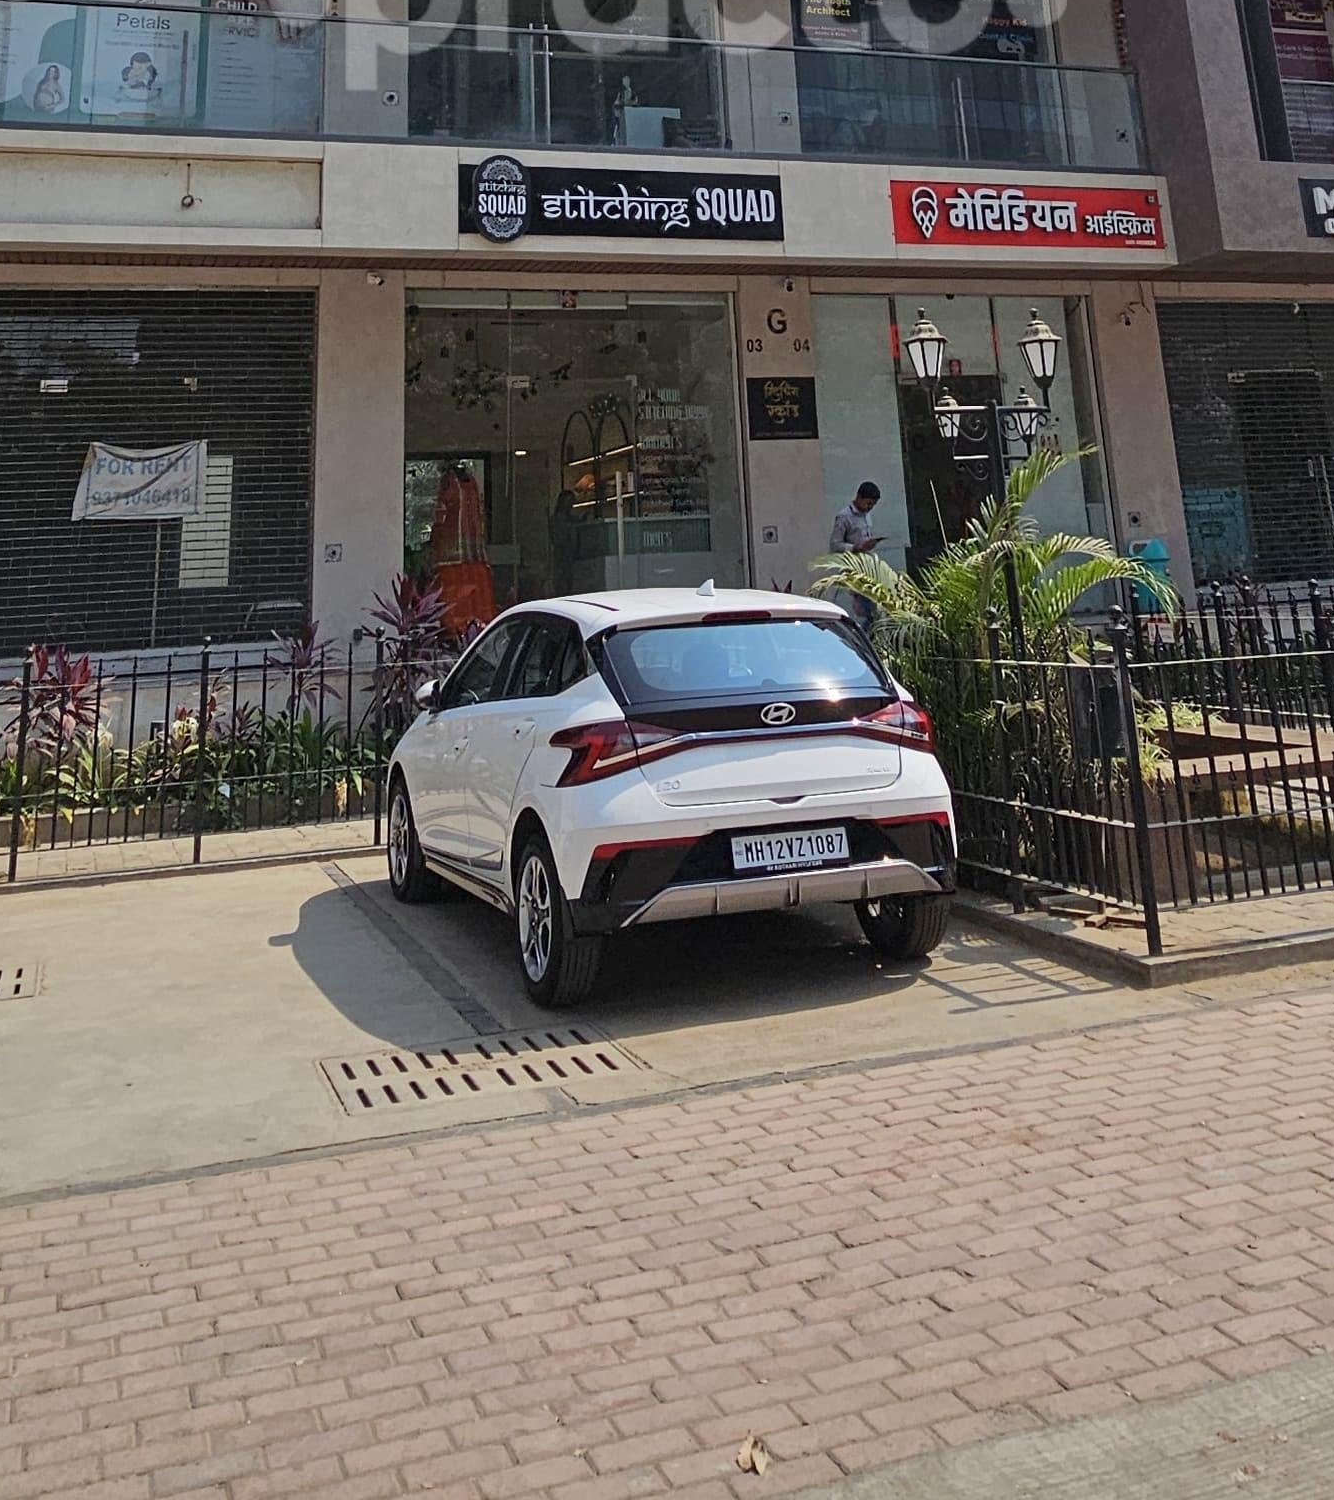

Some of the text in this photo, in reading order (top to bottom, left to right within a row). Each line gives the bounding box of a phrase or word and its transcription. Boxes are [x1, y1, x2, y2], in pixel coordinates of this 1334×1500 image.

[215, 0, 259, 13] CHILD
[805, 5, 852, 17] Architect
[116, 12, 171, 30] Petals
[478, 193, 527, 217] SQUAD
[540, 183, 776, 229] stitching SQUAD
[945, 187, 1078, 232] मेरिडियन
[765, 307, 789, 336] G
[746, 337, 811, 354] 03 04
[96, 457, 134, 476] FOR
